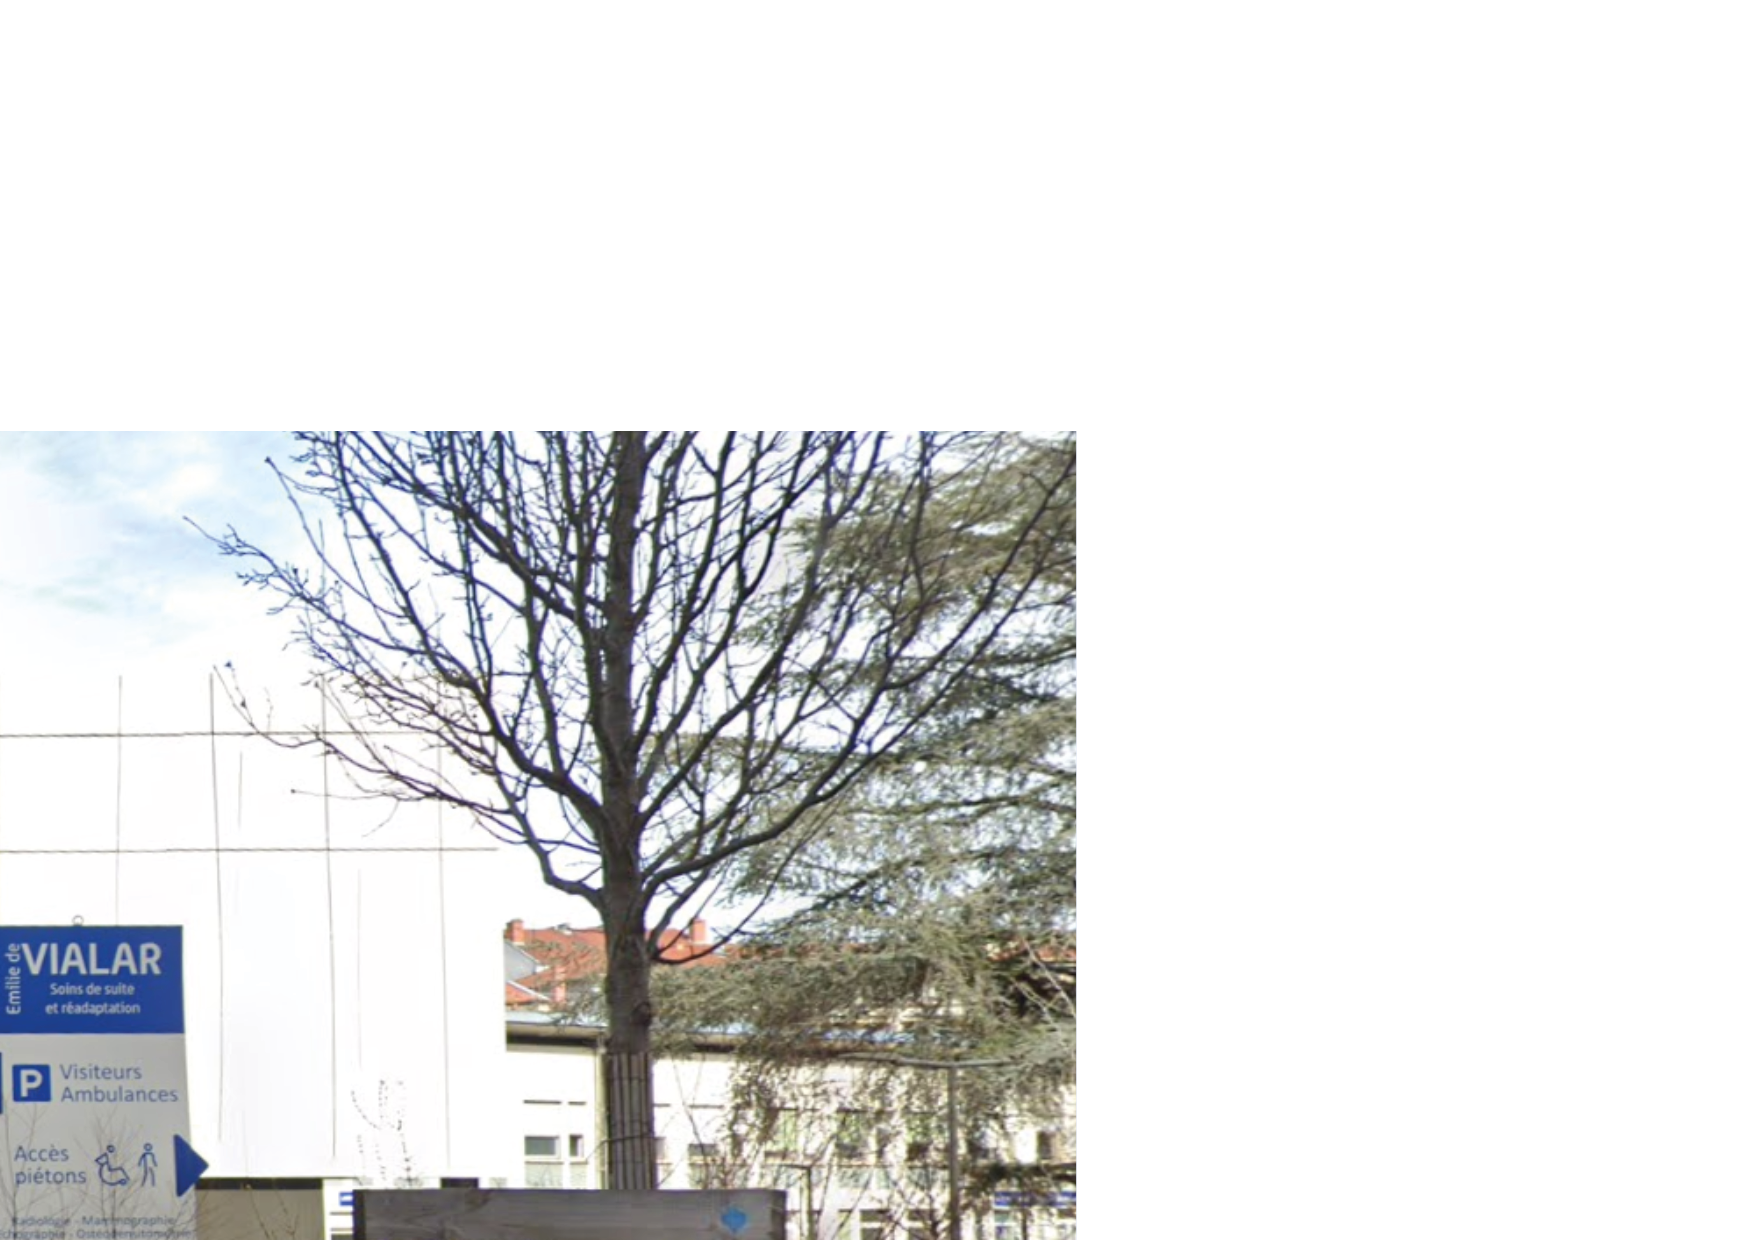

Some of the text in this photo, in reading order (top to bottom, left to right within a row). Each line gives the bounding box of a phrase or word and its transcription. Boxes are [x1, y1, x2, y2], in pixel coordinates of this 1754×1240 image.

[21, 942, 162, 975] VIALAR
[5, 943, 21, 1015] Emilie de
[50, 982, 135, 996] Soins de suite
[45, 1002, 140, 1016] et réadaptation
[60, 1064, 142, 1081] Visiteurs
[60, 1085, 178, 1103] Ambulances
[14, 1145, 69, 1163] Accès
[15, 1168, 86, 1187] piétons
